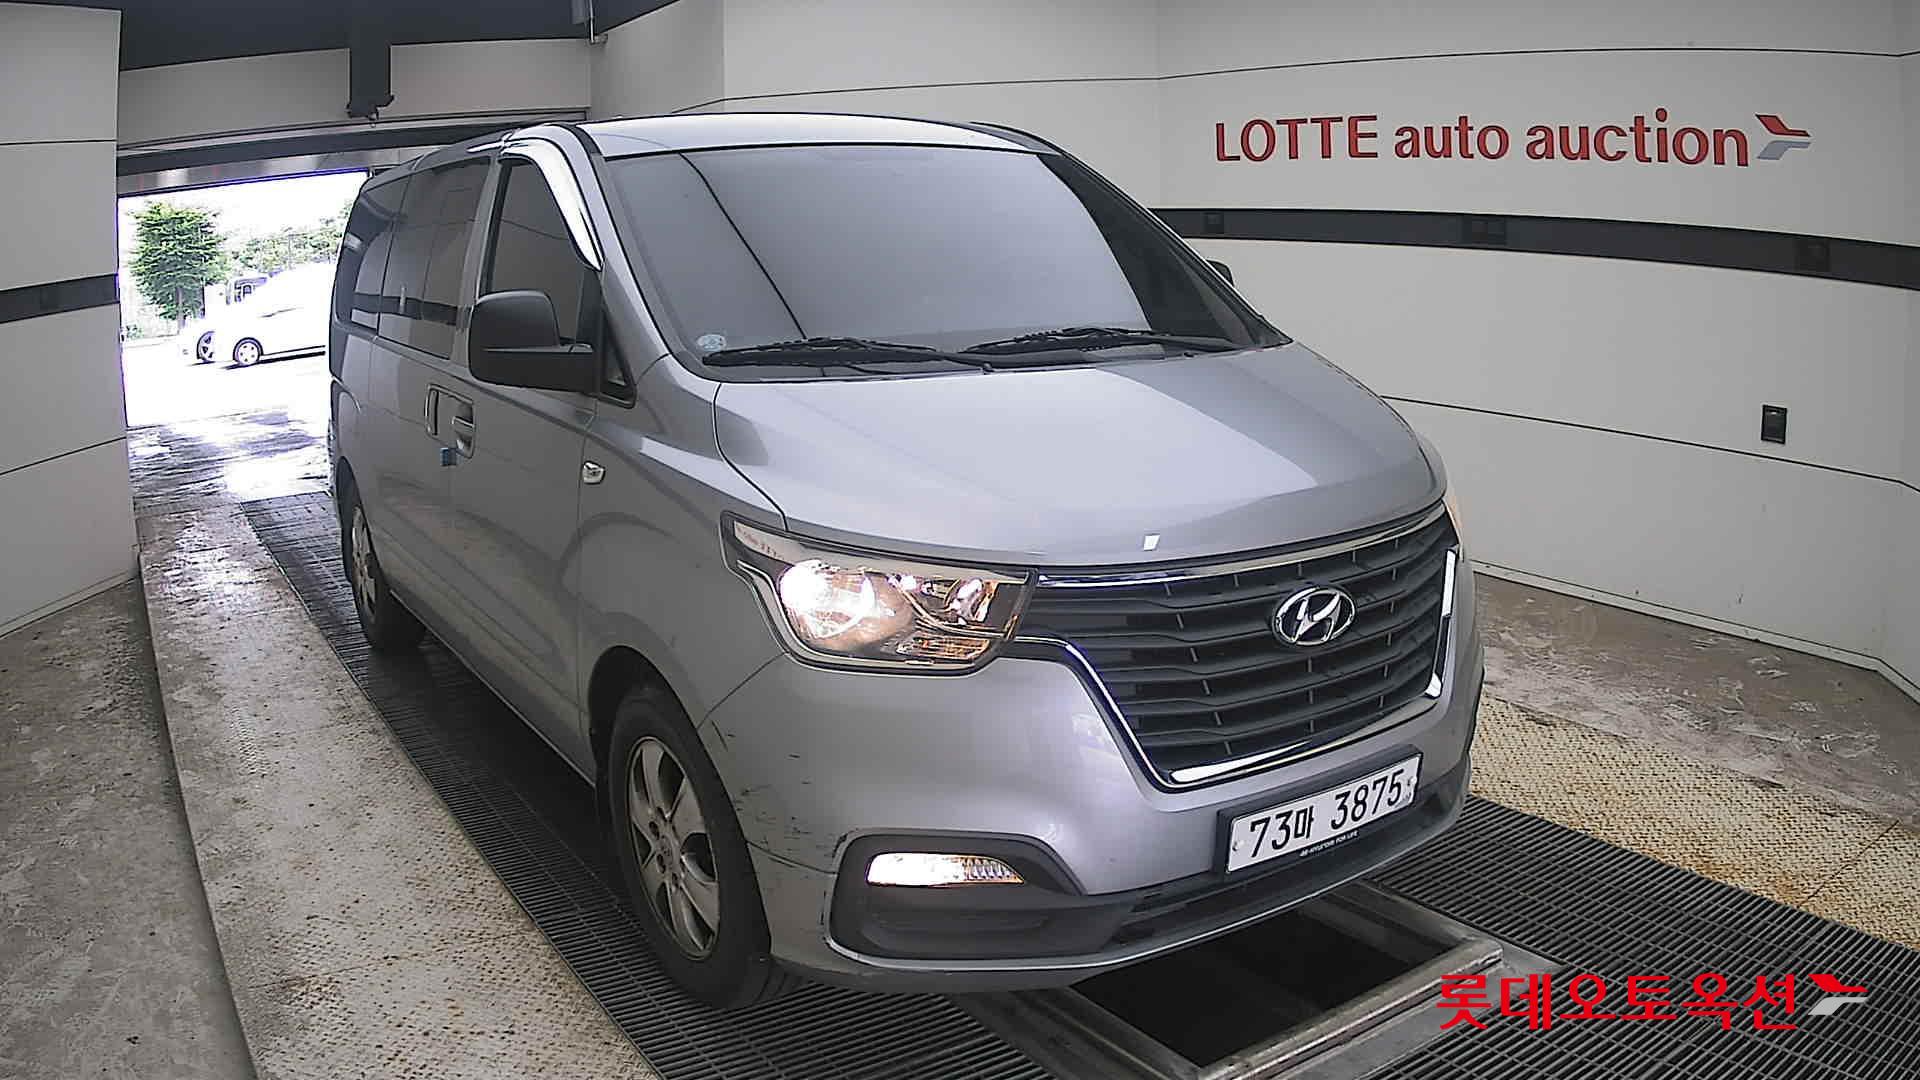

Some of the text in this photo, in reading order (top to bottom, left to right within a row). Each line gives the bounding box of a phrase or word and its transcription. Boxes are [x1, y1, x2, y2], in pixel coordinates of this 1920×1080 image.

[1214, 106, 1750, 167] LOTTE auto auction
[1250, 769, 1405, 858] 73마 3875
